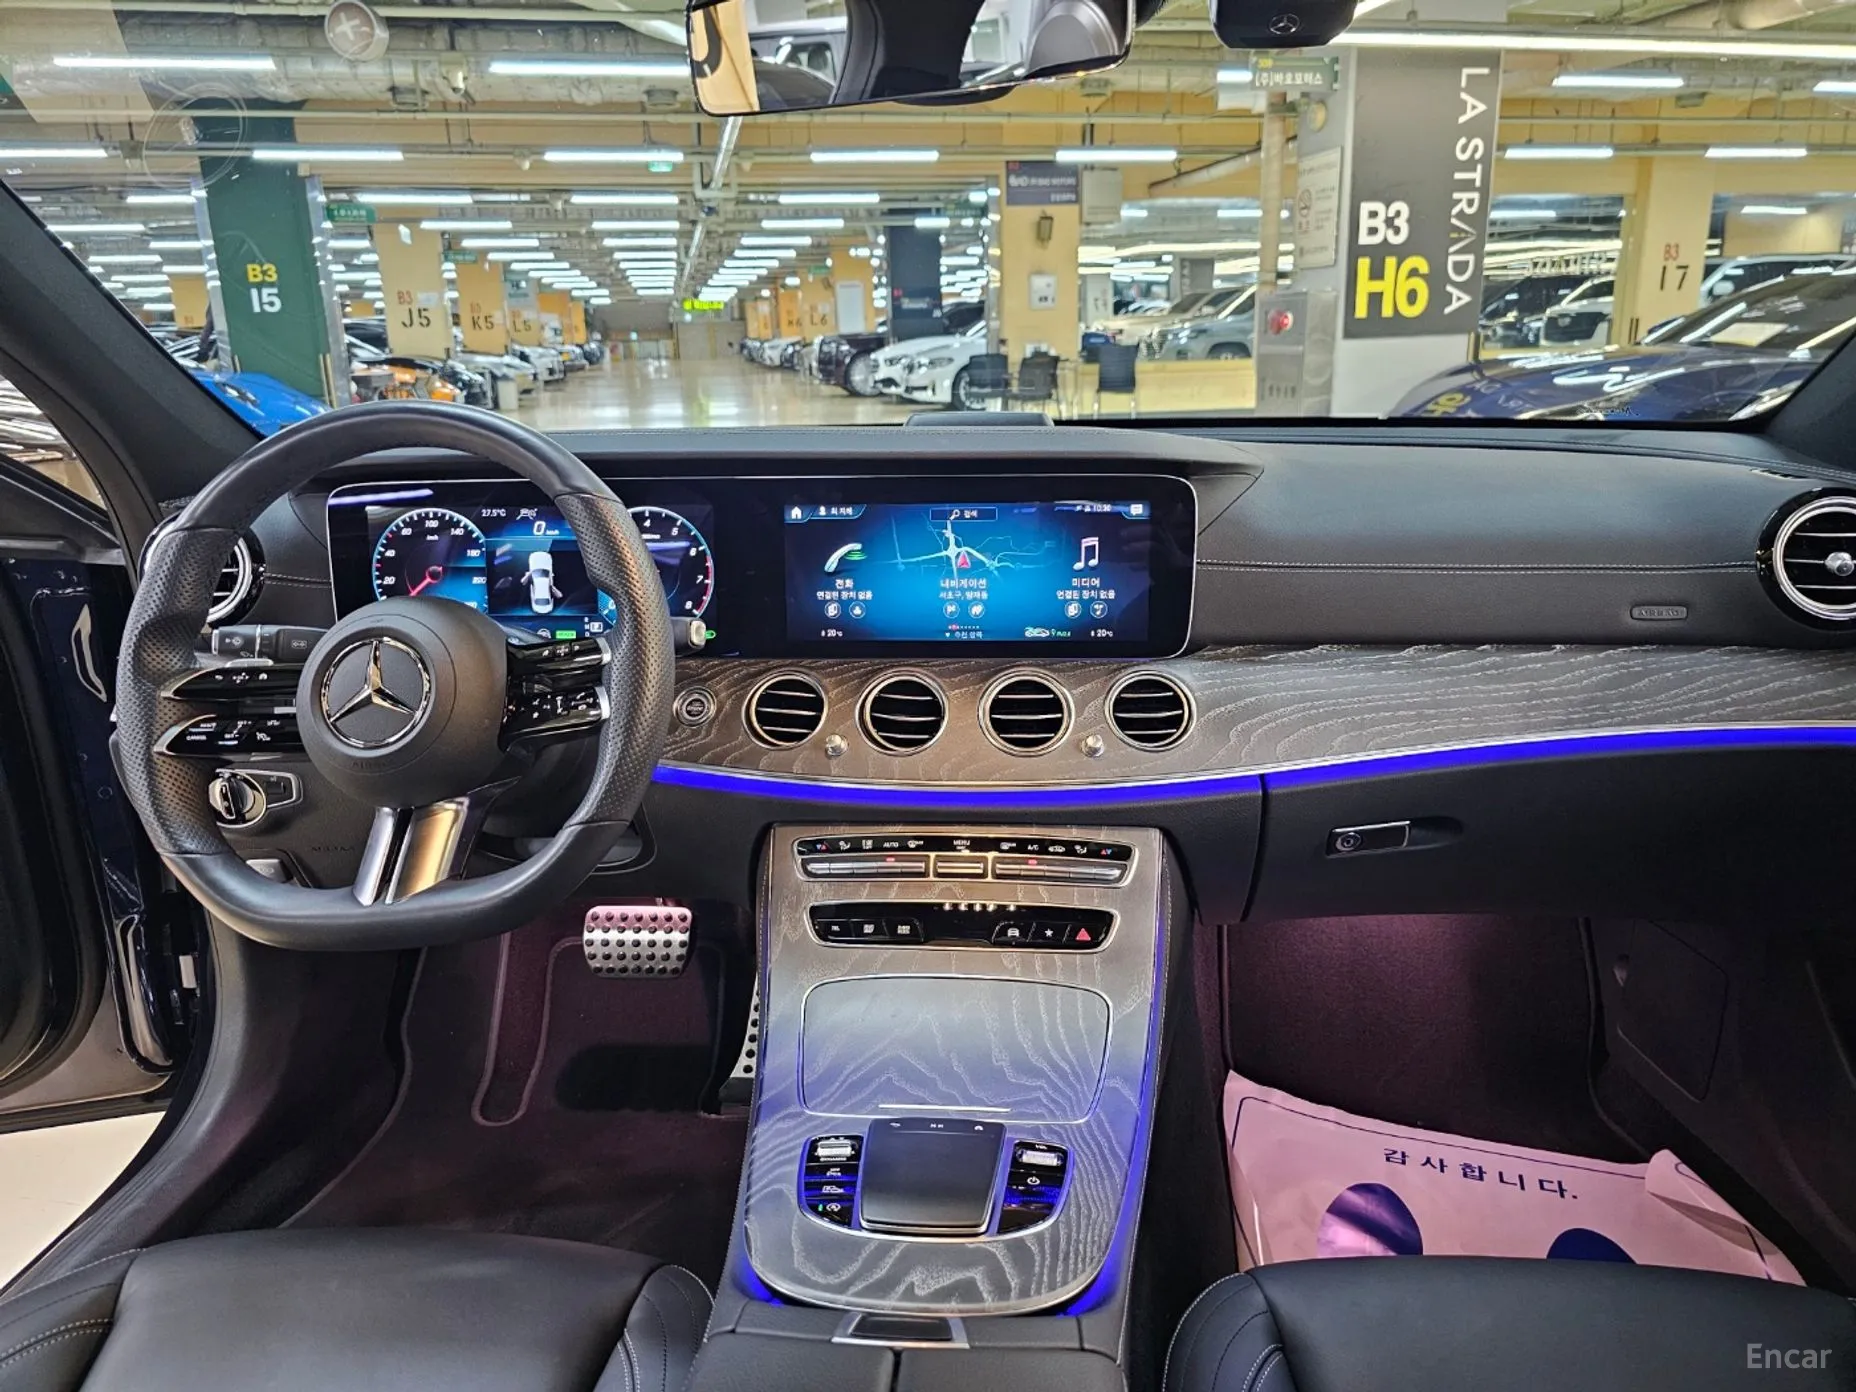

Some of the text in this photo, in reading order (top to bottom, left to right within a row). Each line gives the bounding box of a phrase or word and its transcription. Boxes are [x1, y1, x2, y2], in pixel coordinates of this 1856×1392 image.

[1443, 67, 1490, 315] LA STRADA
[1358, 200, 1410, 245] B3
[1663, 243, 1680, 262] B3
[246, 263, 278, 283] B3
[1354, 255, 1430, 319] H6
[397, 290, 413, 305] B3
[401, 308, 432, 329] J5
[471, 315, 495, 331] K5
[533, 520, 546, 536] 0
[643, 519, 651, 527] 4
[450, 528, 465, 536] 140
[671, 527, 679, 536] 5
[384, 549, 396, 557] 40
[383, 576, 396, 585] 20
[696, 575, 704, 584] 7
[940, 578, 987, 590] 내비게이션
[1071, 577, 1100, 588] 미디어
